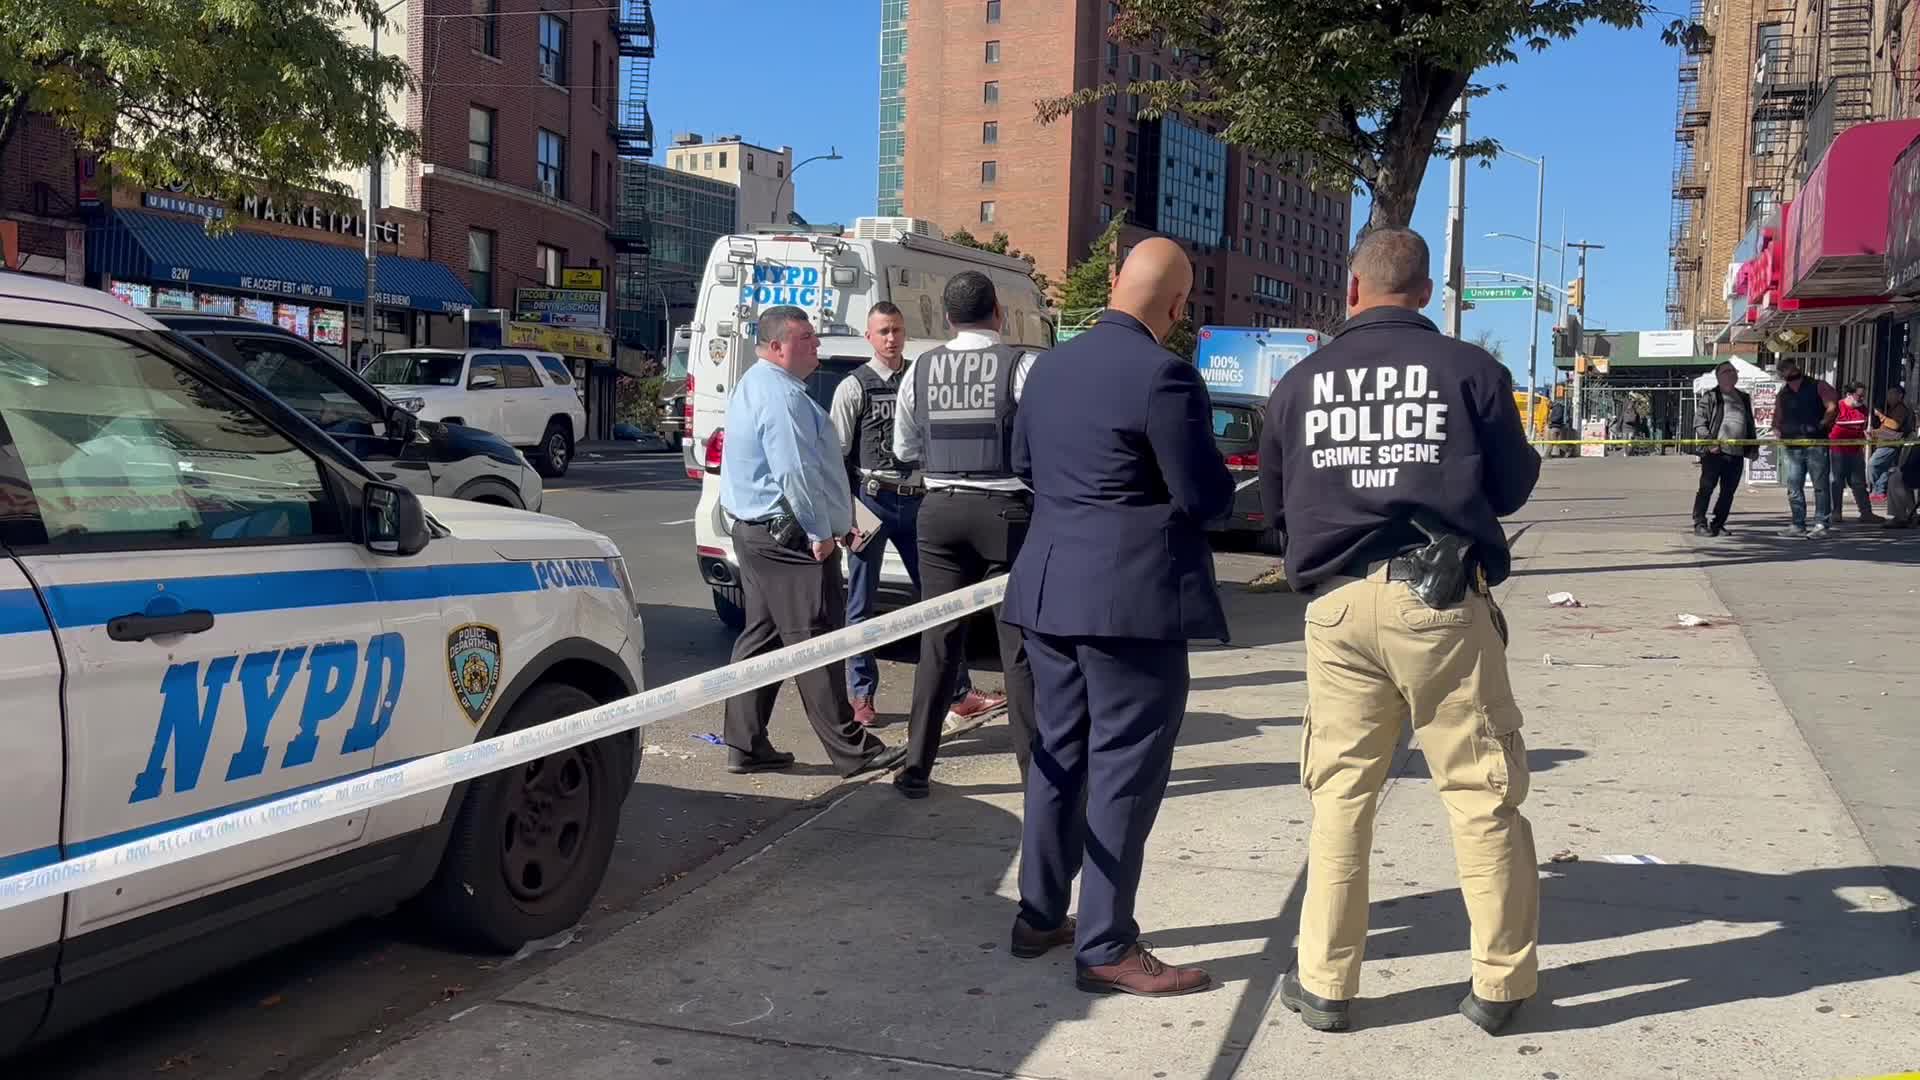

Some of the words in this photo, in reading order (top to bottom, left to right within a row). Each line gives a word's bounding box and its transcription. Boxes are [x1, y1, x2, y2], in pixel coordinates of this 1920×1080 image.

[753, 262, 818, 286] NYPD
[241, 276, 252, 288] WE
[253, 278, 281, 292] ACCEPT
[283, 281, 297, 294] EBT
[301, 283, 314, 296] WIC
[319, 285, 333, 297] ATM
[520, 290, 550, 300] INCOME
[552, 291, 564, 301] TAX
[570, 292, 600, 302] CENTER
[741, 286, 833, 306] POLICE
[1471, 289, 1517, 297] University
[533, 302, 566, 312] DRIVING
[568, 303, 599, 312] SCHOOL
[928, 352, 998, 385] NYPD
[1209, 354, 1240, 369] 100%
[1200, 368, 1244, 382] WIIINGS
[1313, 364, 1439, 405] N.Y.P.D.
[928, 383, 996, 410] POLICE
[871, 401, 897, 420] POL
[1305, 402, 1448, 446] POLICE
[1312, 446, 1372, 469] CRIME
[1378, 443, 1440, 464] SCENE
[1351, 468, 1399, 488] UNIT
[532, 559, 600, 590] POLICE
[459, 627, 487, 641] POLICE
[449, 638, 498, 658] DEPARTMENT
[128, 631, 406, 805] NYPD
